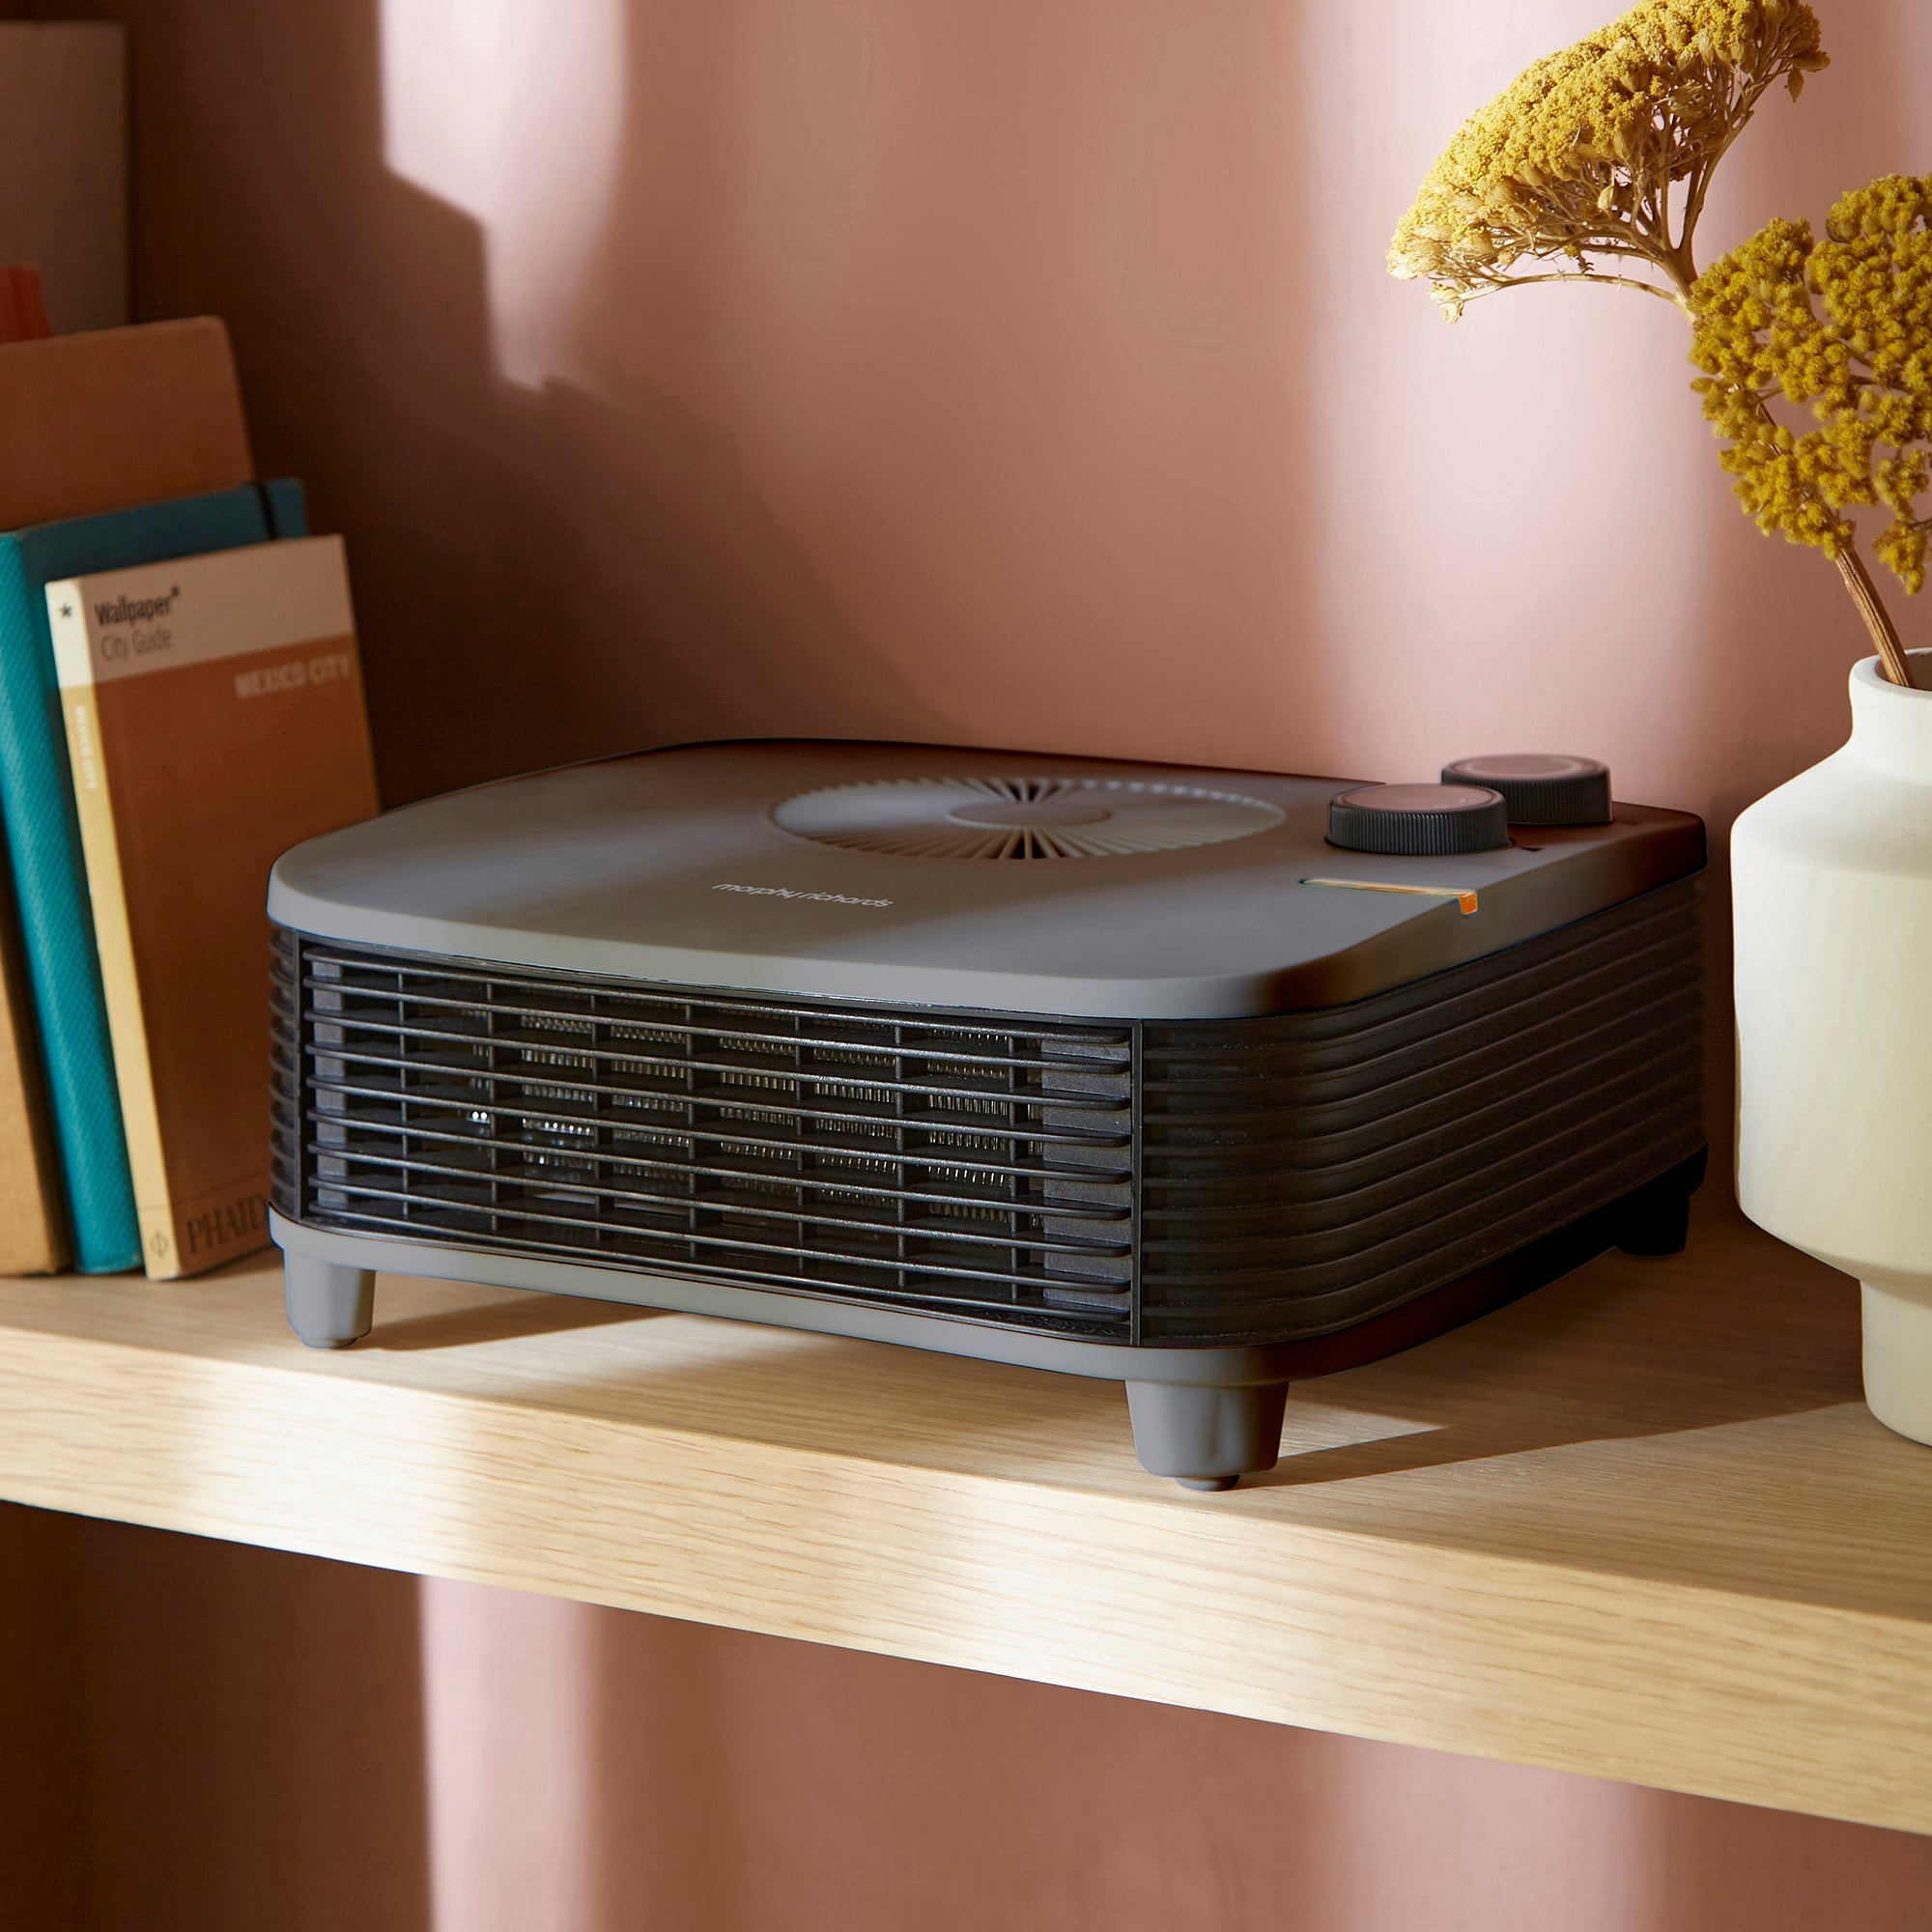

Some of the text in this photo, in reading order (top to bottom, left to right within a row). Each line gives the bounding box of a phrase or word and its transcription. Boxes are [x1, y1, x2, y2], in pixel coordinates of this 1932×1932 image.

[101, 627, 172, 662] City Guide
[234, 653, 351, 699] MEXICO CITY
[711, 883, 895, 907] morphy richards
